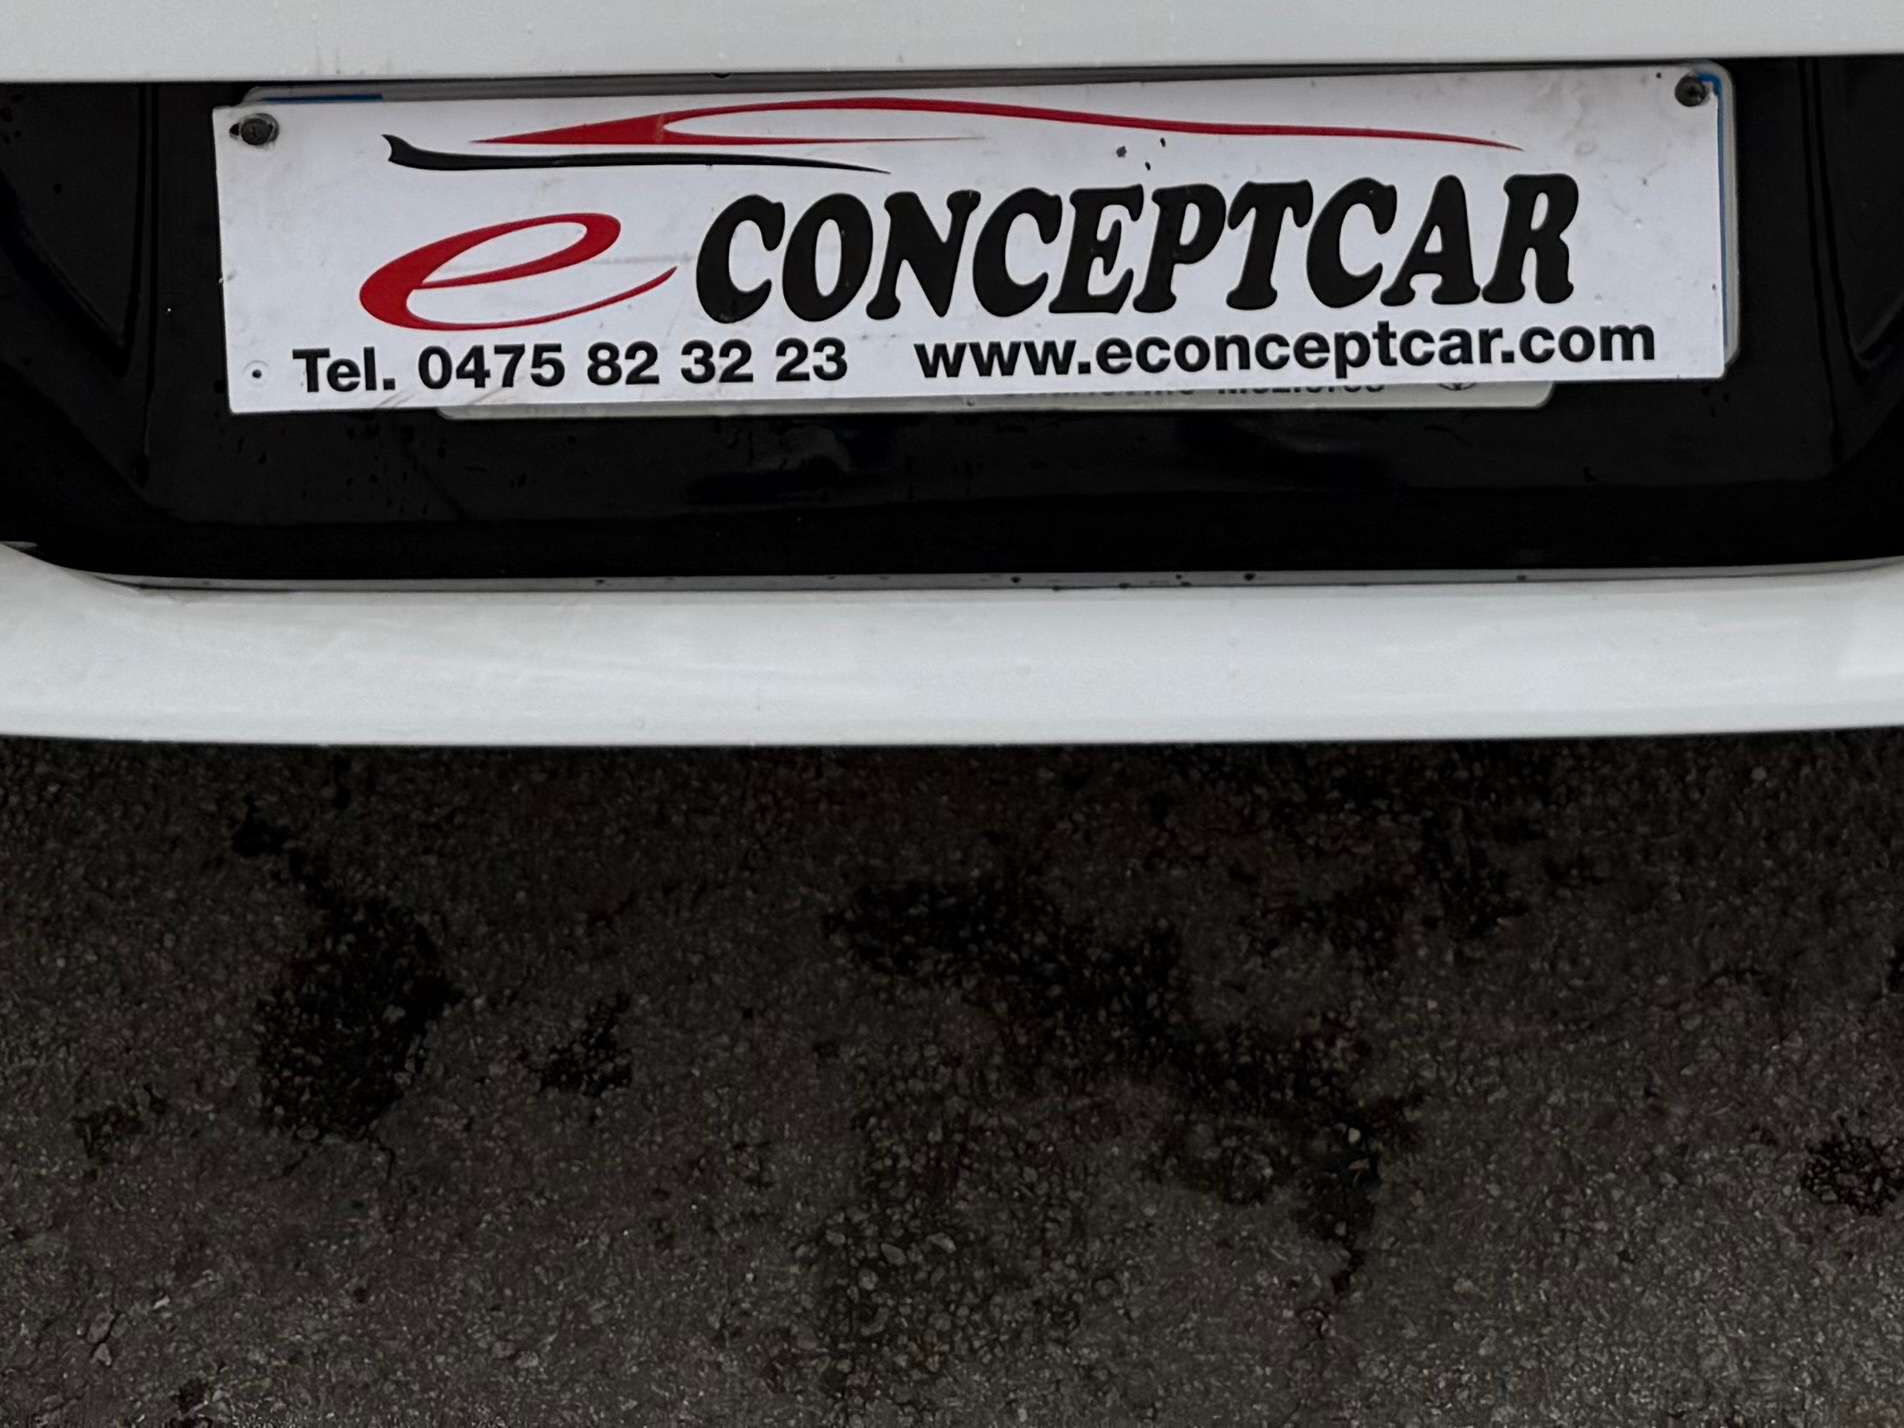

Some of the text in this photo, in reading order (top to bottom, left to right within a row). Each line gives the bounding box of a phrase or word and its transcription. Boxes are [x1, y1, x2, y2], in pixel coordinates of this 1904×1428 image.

[292, 322, 1655, 393] Tel. 0475 82 32 23 www.econceptcar.com
